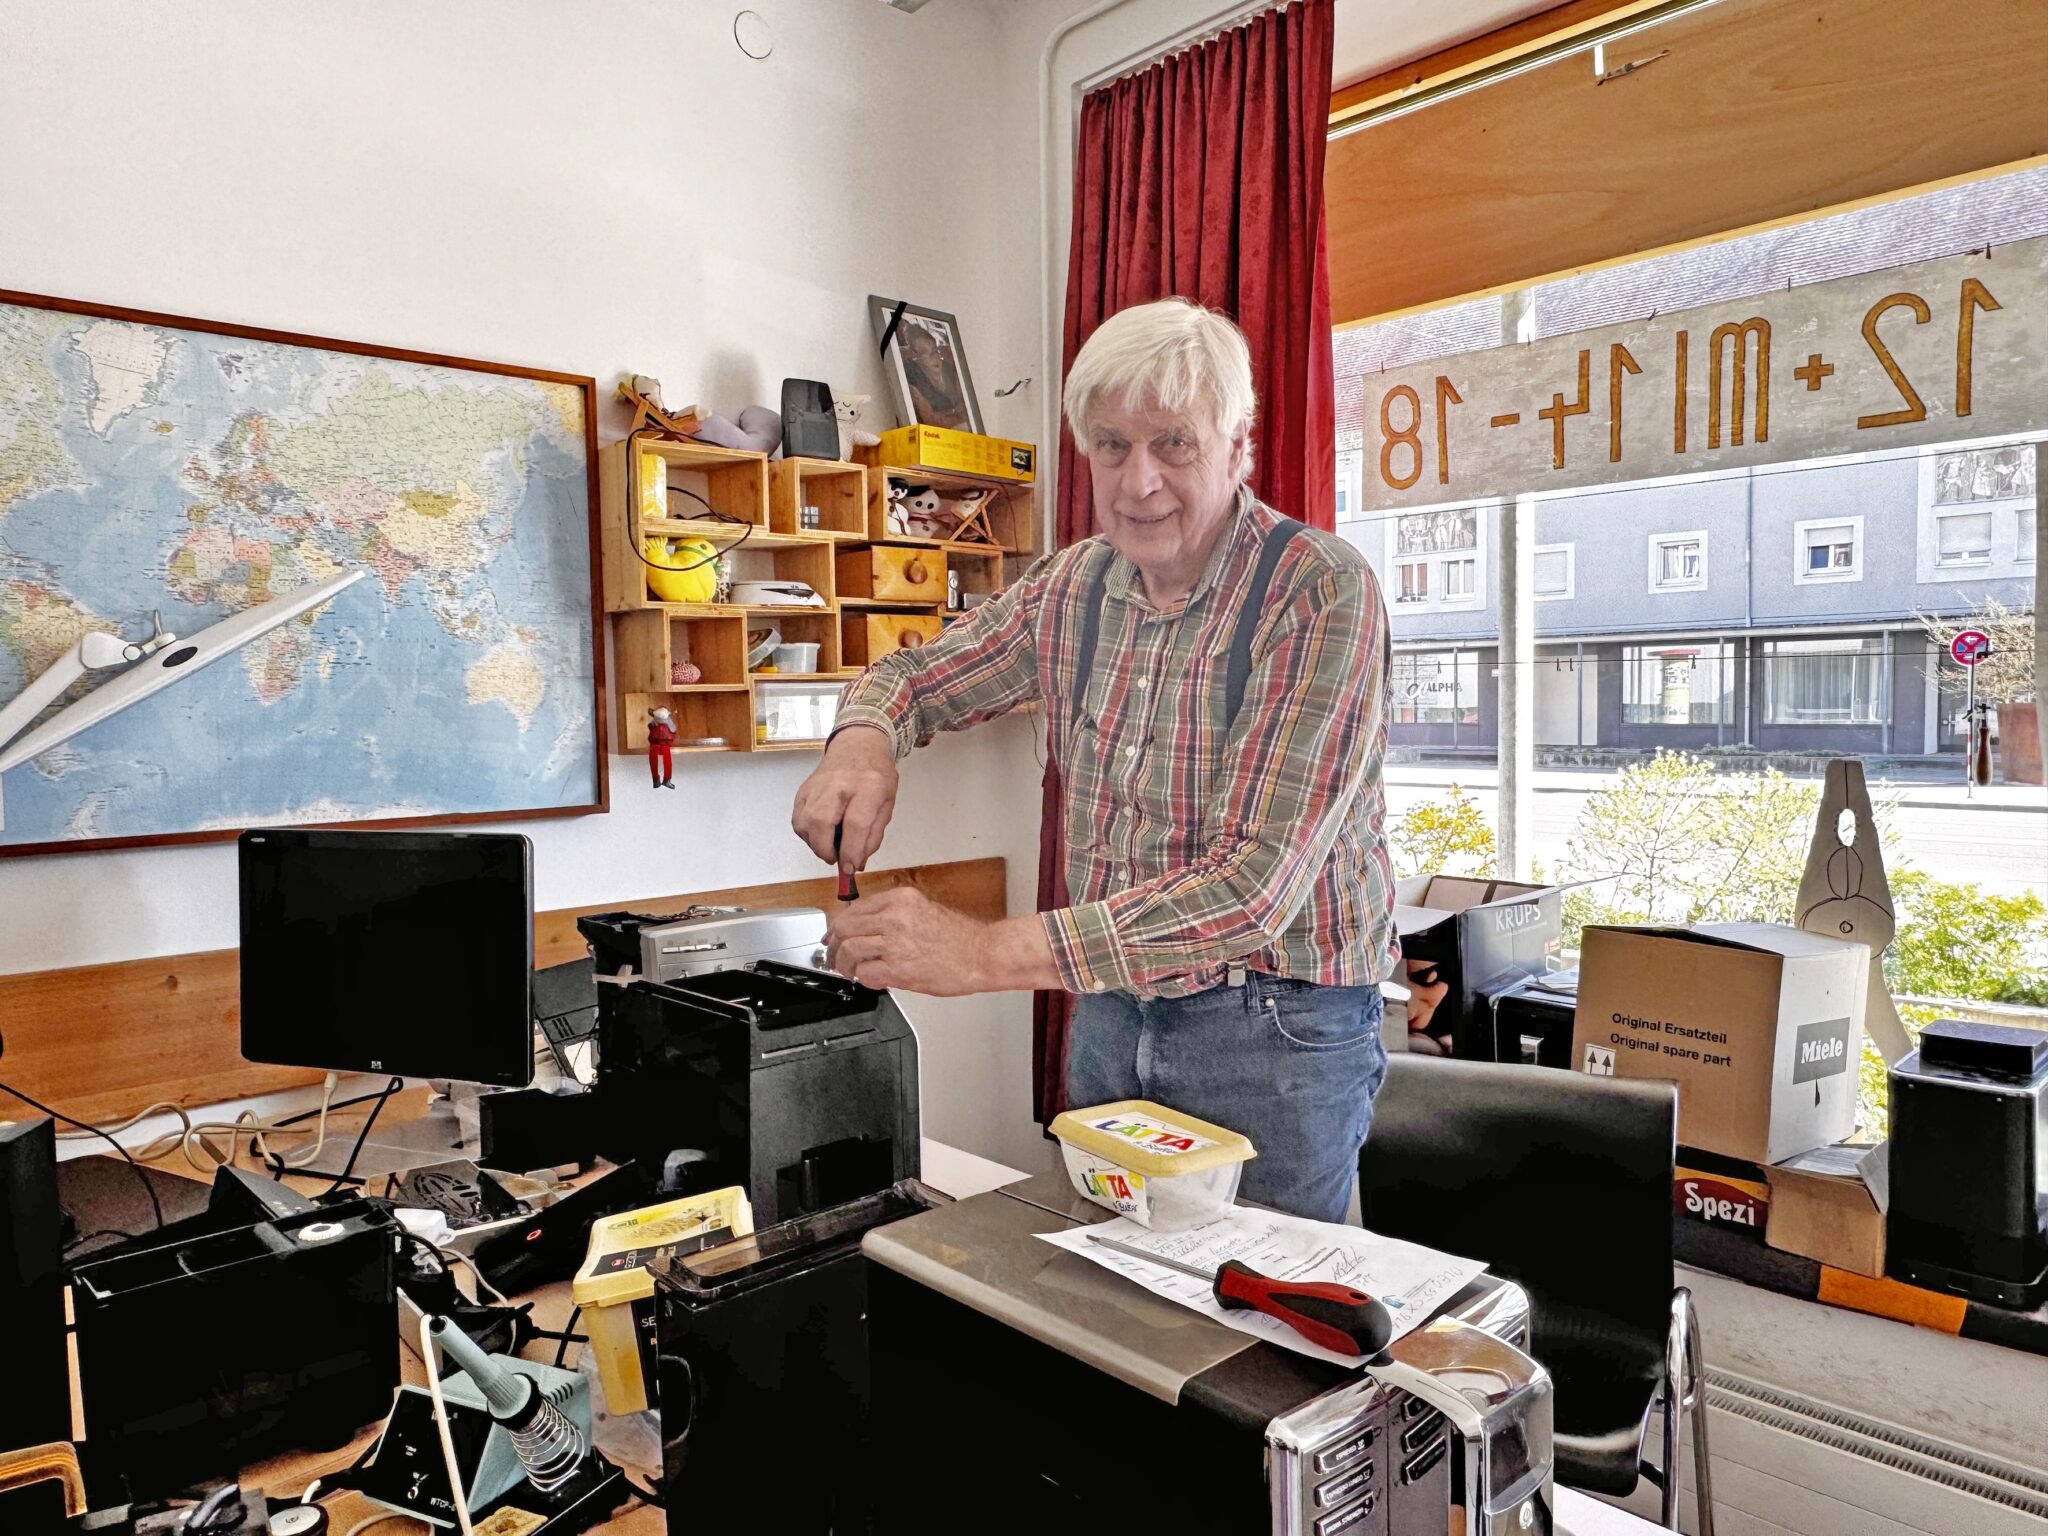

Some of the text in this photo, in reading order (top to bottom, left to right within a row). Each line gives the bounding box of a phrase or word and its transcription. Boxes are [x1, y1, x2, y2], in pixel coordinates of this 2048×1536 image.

[1495, 904, 1541, 932] KRUPS
[1612, 1013, 1727, 1044] Original Ersatzteil
[1610, 1033, 1732, 1067] Original spare part
[1801, 1037, 1843, 1064] Miele
[1096, 1120, 1195, 1151] LÄTTA
[1081, 1168, 1133, 1200] LÄTTA
[1684, 1182, 1755, 1226] Spezi
